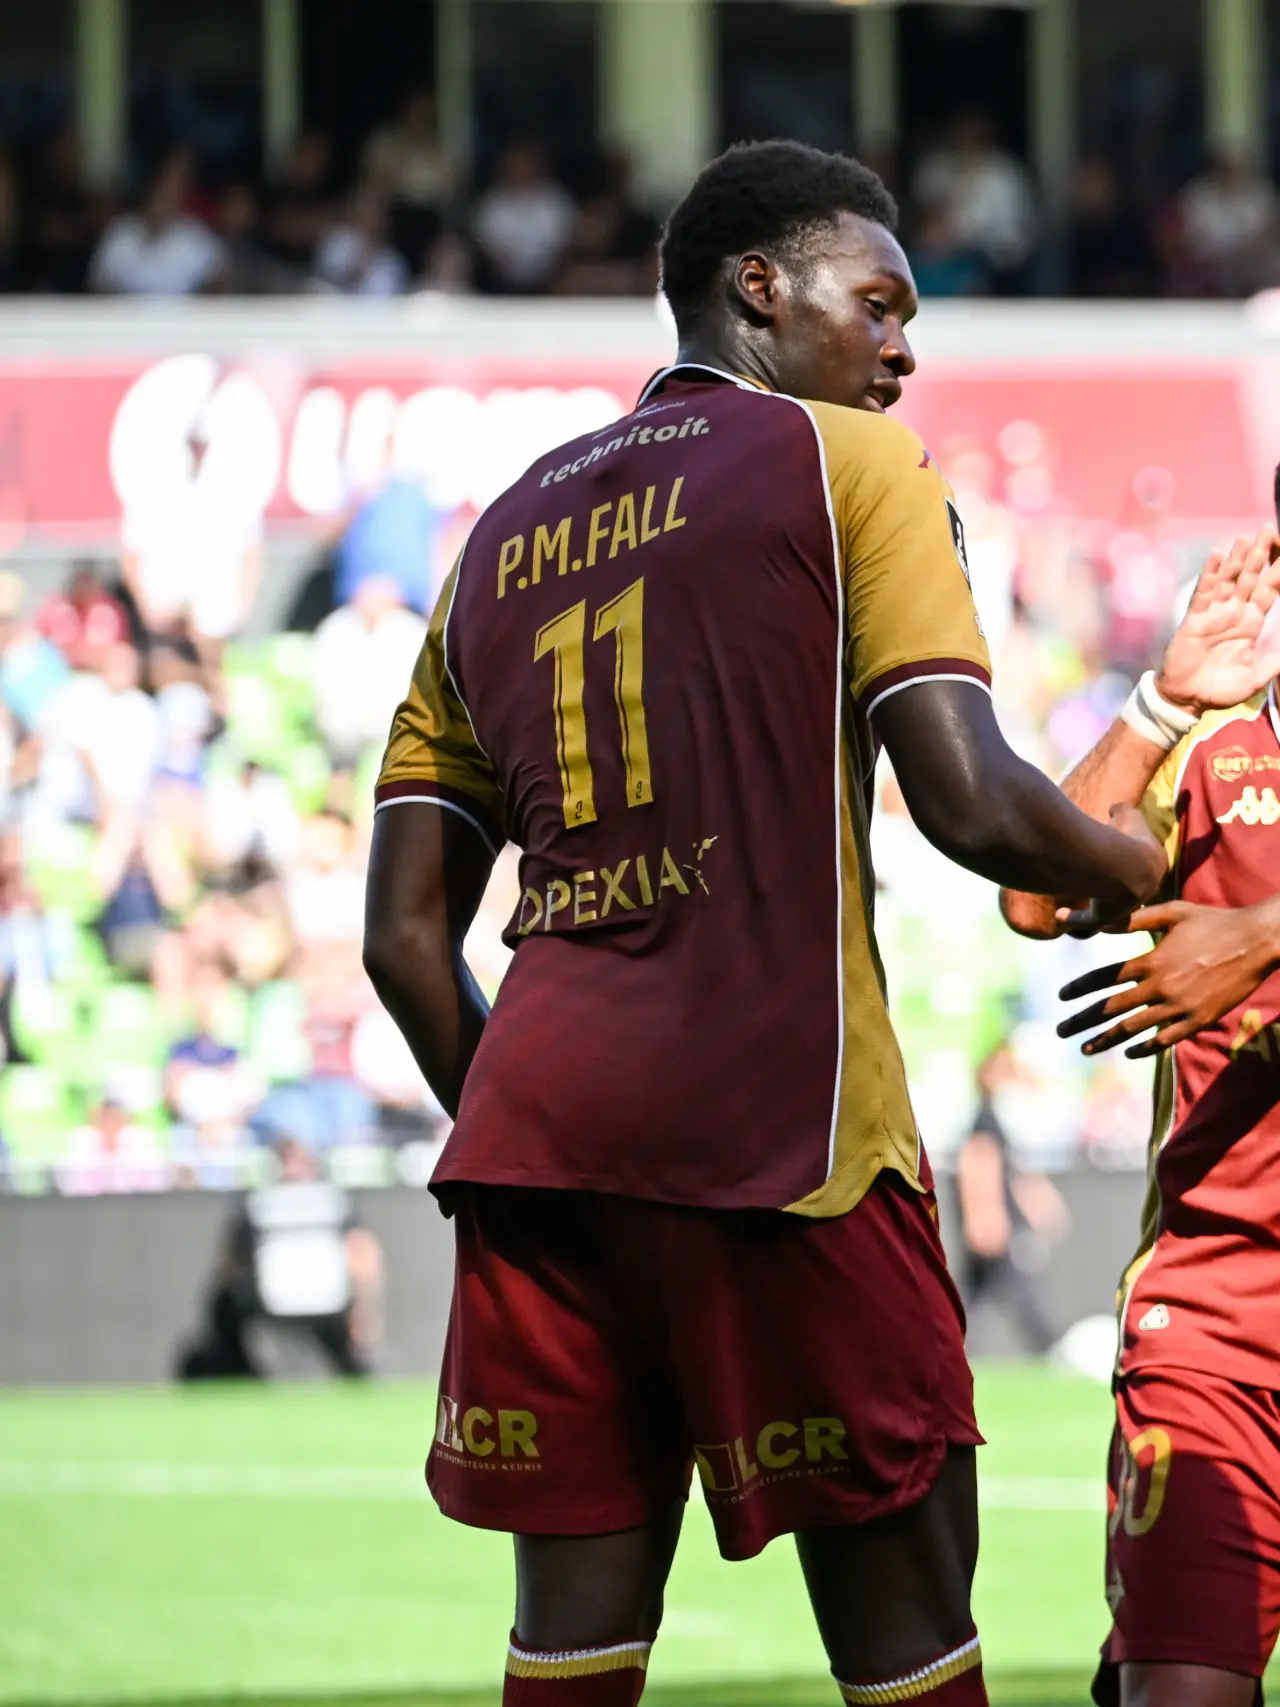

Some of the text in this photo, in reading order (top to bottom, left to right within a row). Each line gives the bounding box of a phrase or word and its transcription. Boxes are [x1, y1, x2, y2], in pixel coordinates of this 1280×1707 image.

[540, 416, 711, 488] technitoit.
[496, 476, 687, 599] P.M.FALL
[534, 576, 654, 829] 11
[451, 1401, 541, 1458] LCR
[734, 1417, 850, 1484] LCR
